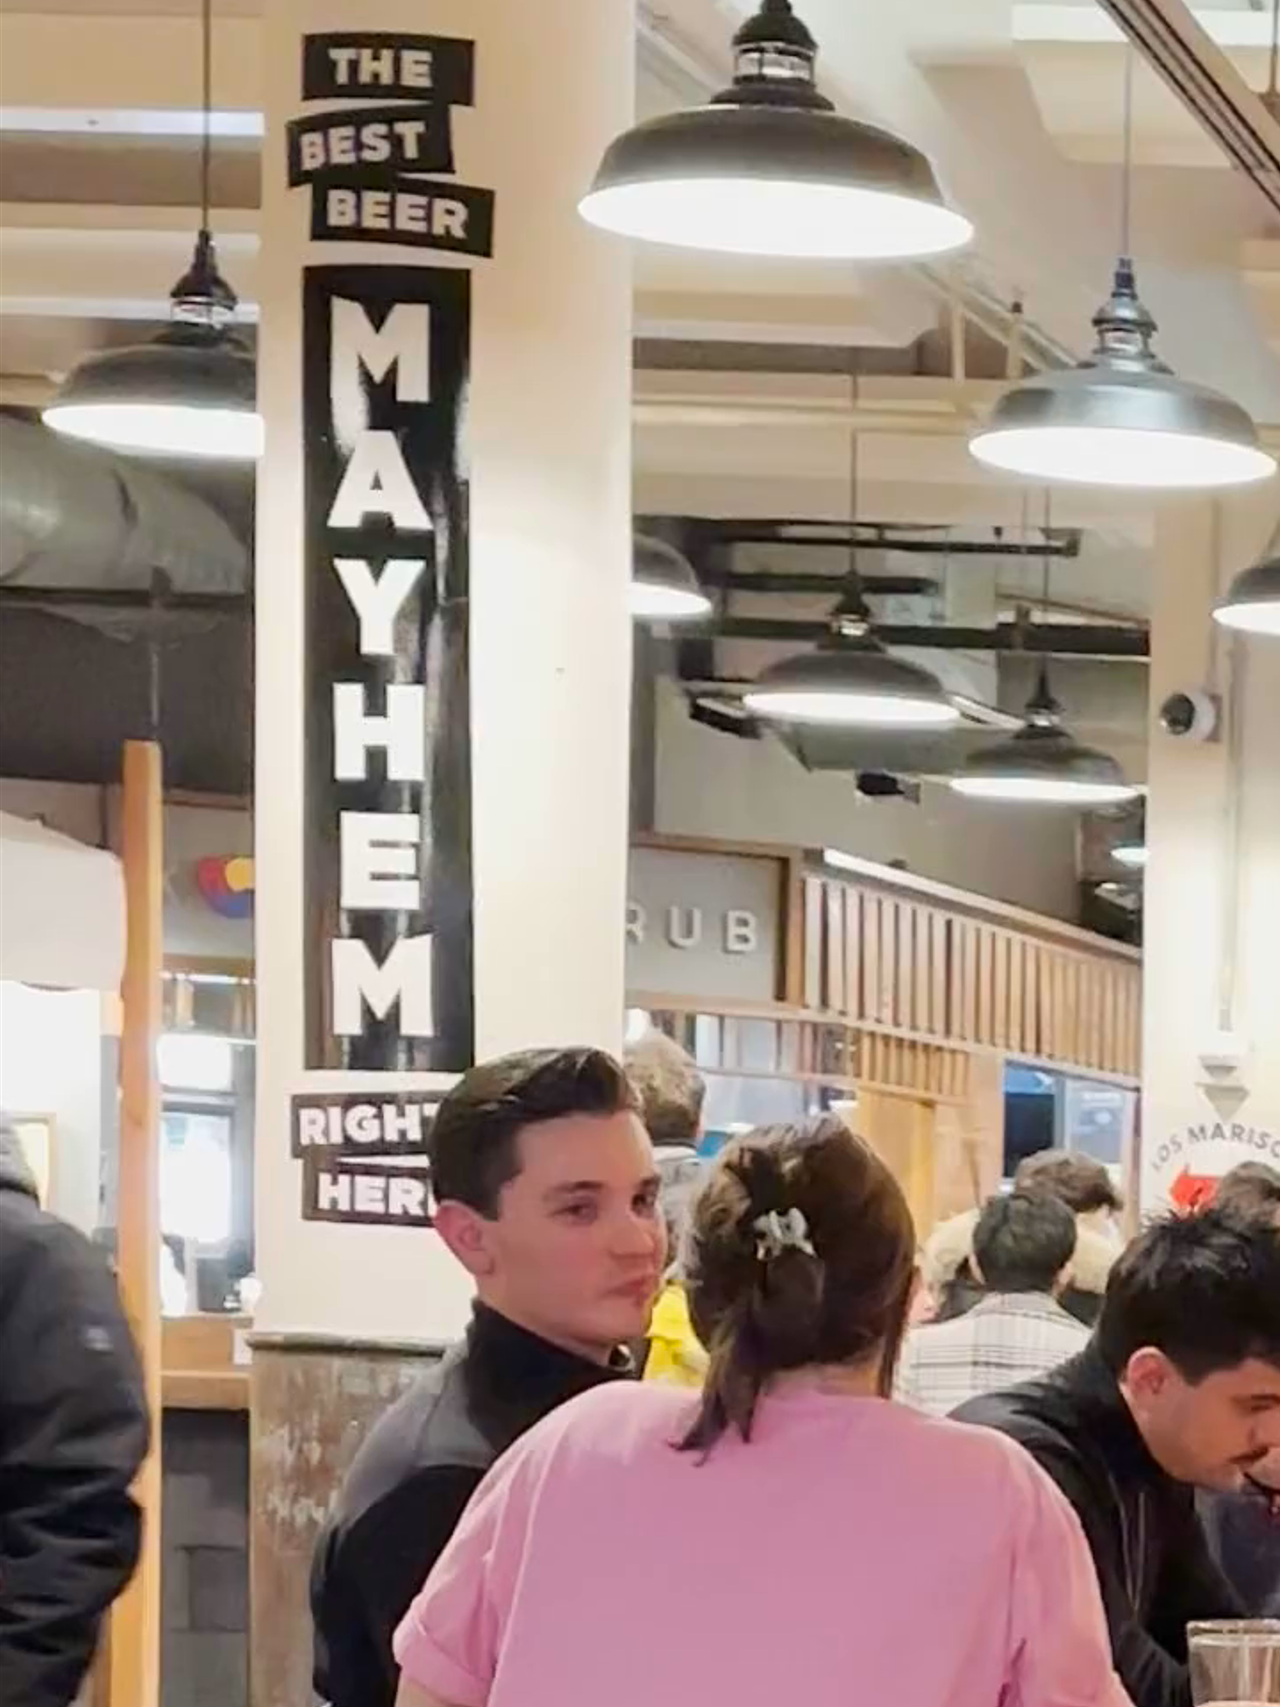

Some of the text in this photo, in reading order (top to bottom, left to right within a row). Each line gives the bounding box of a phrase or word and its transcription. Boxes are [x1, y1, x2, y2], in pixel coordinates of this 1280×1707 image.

[327, 48, 434, 88] THE
[301, 120, 427, 171] BEST
[326, 189, 469, 239] BEER
[327, 296, 433, 1037] MAYHEM
[1150, 1133, 1183, 1172] LOS
